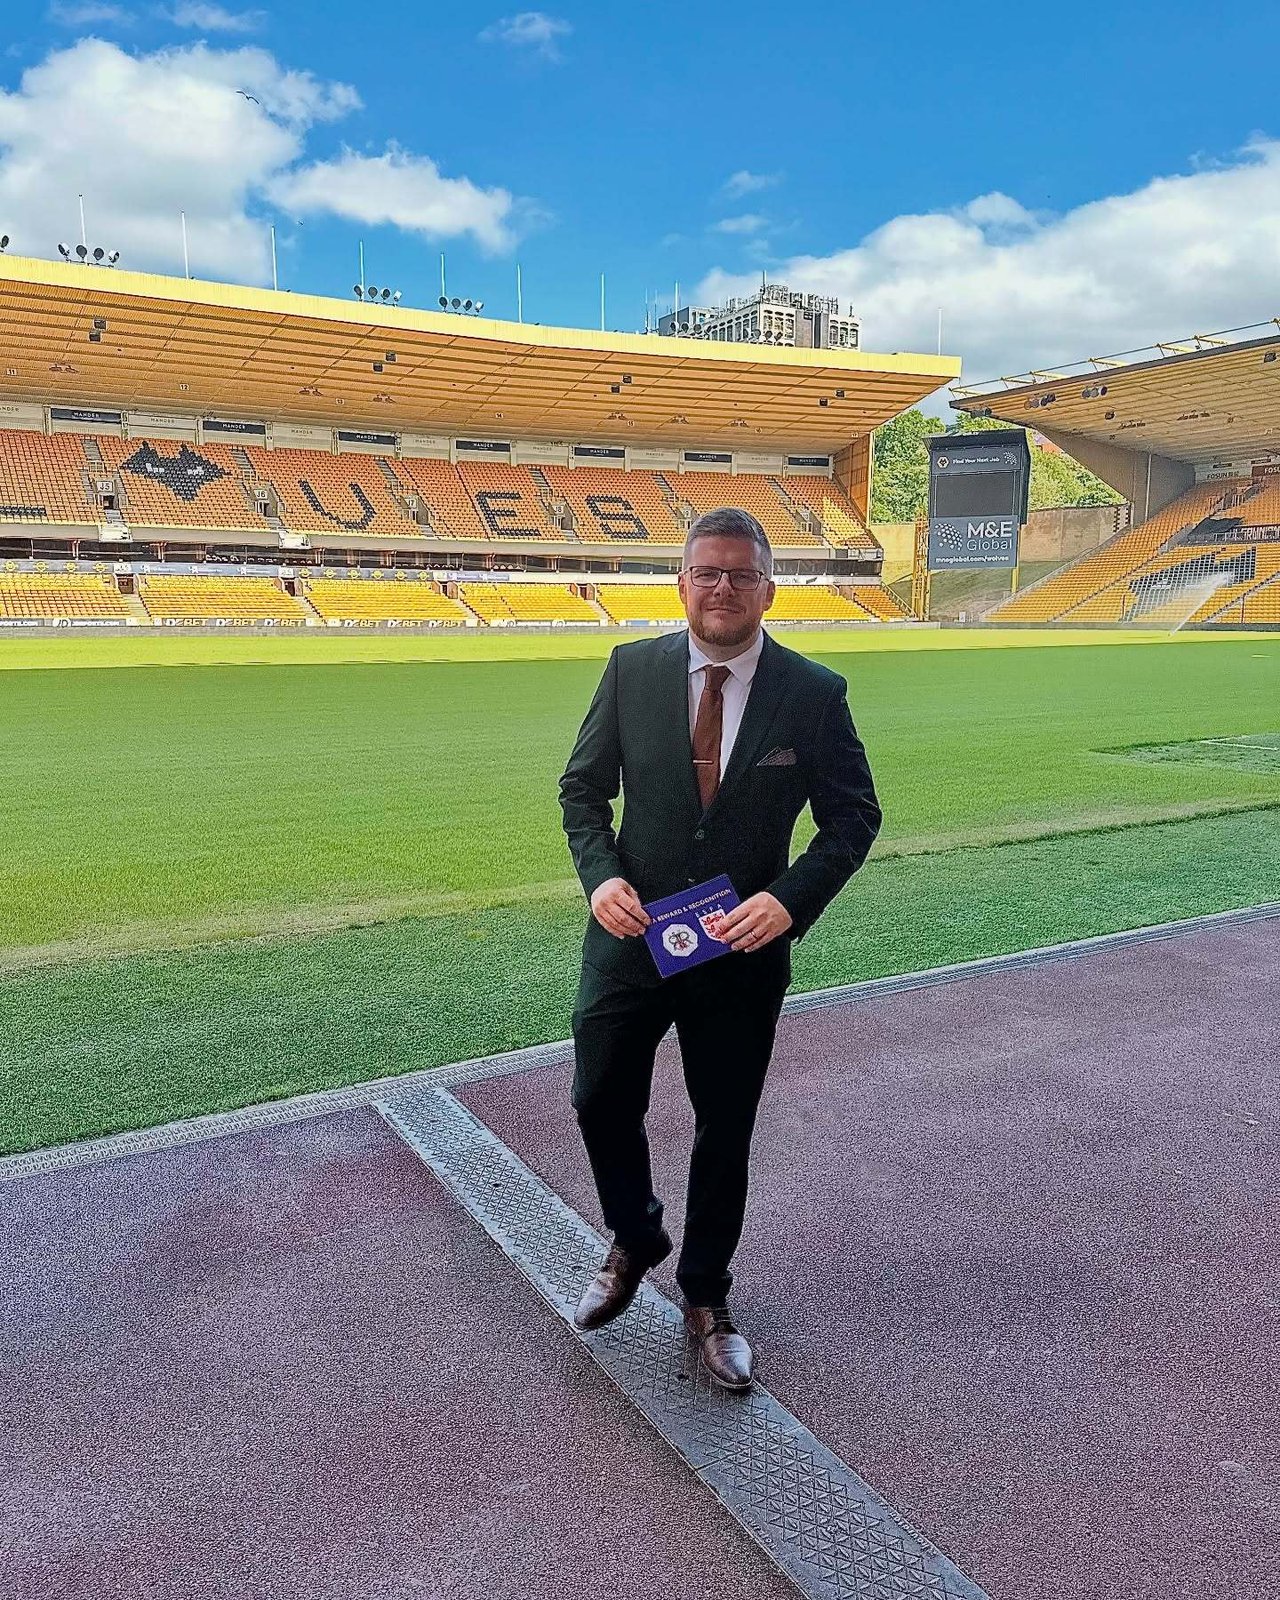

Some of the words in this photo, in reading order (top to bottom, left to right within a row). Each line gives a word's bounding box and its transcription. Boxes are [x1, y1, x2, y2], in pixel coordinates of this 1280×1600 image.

[967, 521, 1013, 538] M&E
[966, 539, 1012, 551] Global
[657, 908, 683, 923] REWARD
[688, 888, 732, 910] RECOGNITION
